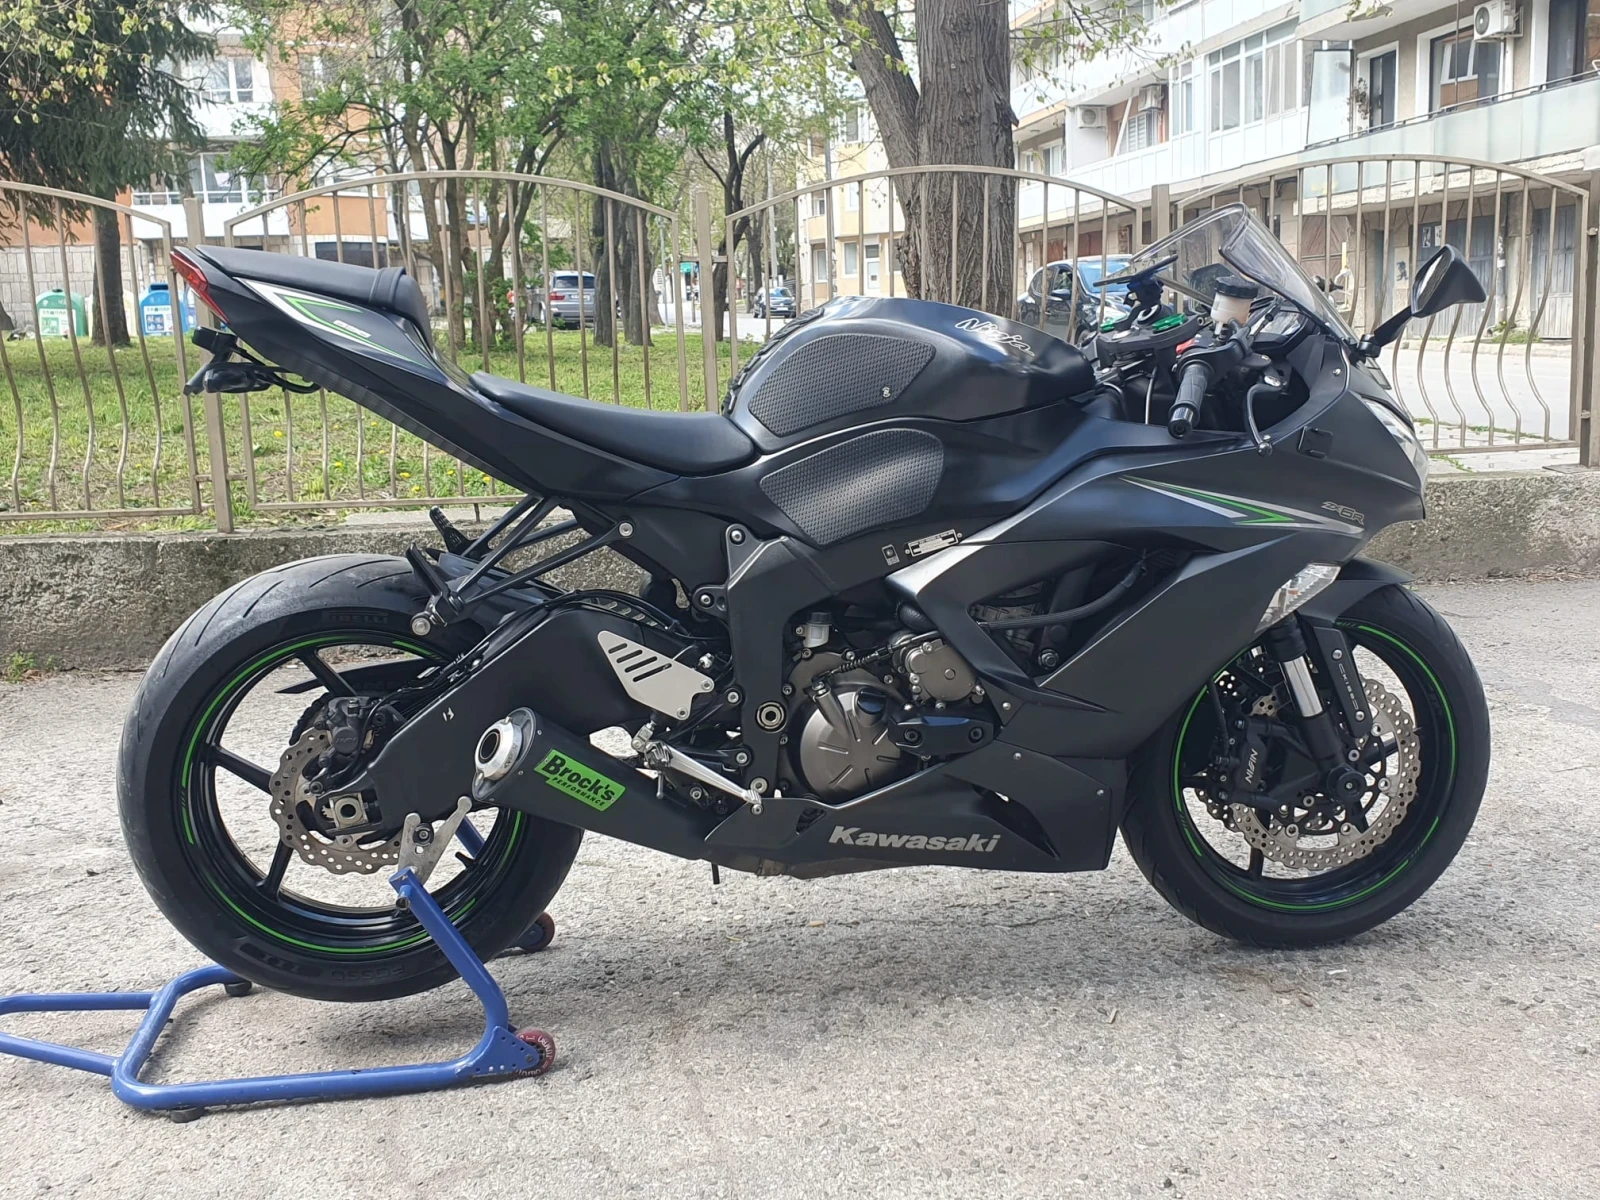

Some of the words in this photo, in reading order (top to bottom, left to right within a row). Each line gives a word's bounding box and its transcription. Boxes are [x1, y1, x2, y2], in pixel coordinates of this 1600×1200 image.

[955, 318, 1035, 357] Ninja
[541, 754, 616, 801] Brock's
[551, 776, 606, 807] PERFORMANCE
[828, 825, 1002, 852] Kawasaki
